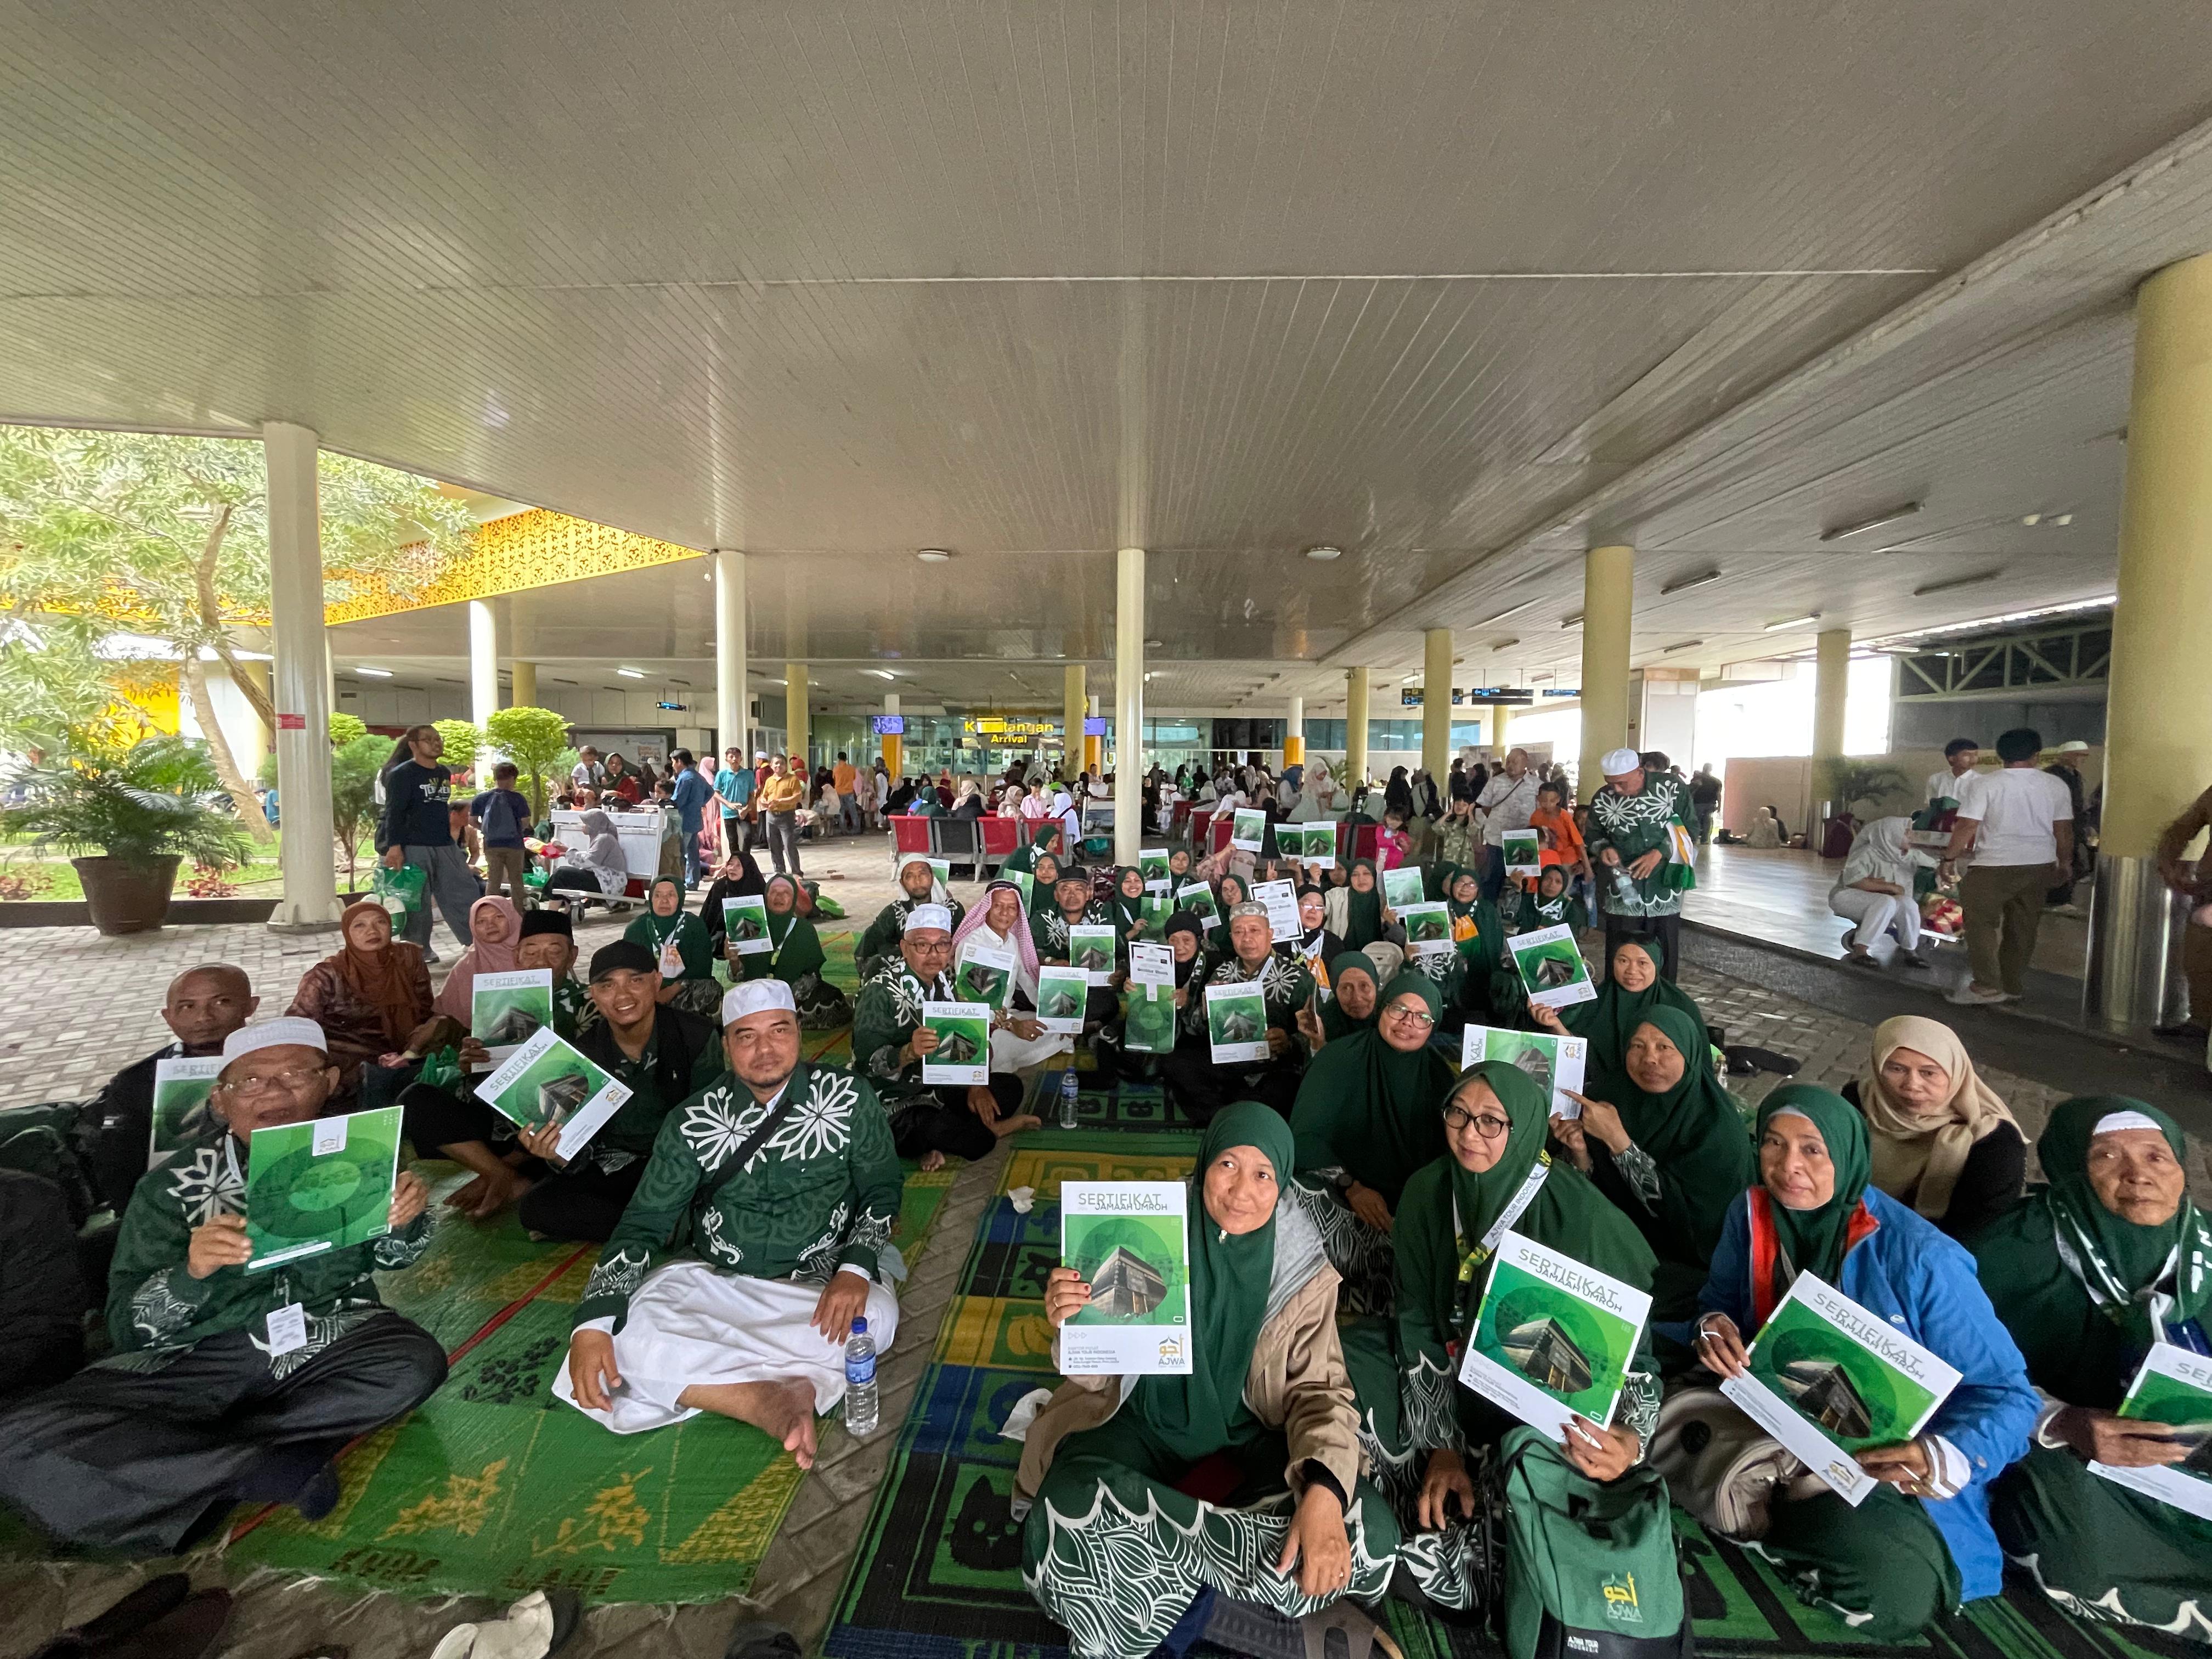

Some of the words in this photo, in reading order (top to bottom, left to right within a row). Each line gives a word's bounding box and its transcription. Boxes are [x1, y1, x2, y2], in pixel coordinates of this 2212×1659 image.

[964, 721, 1053, 734] Ktangan
[991, 735, 1028, 743] Arrival
[484, 975, 537, 986] SERTIFIKAT
[490, 1043, 543, 1091] SERTIFIKAT
[1078, 1193, 1162, 1206] SERTIFIKAT
[1095, 1203, 1133, 1211] JAMAAH
[1135, 1203, 1168, 1211] UMROH
[1490, 1220, 1506, 1239] AJWA
[1503, 1203, 1517, 1220] TOUR
[1518, 1248, 1619, 1302] SERTIFIKAT
[1534, 1266, 1581, 1293] JAMAAH
[1583, 1288, 1623, 1313] UMROH
[1814, 1293, 1923, 1366] SERTIFIKAT
[1830, 1315, 1881, 1351] JAMAAH
[1881, 1345, 1925, 1380] UMROH
